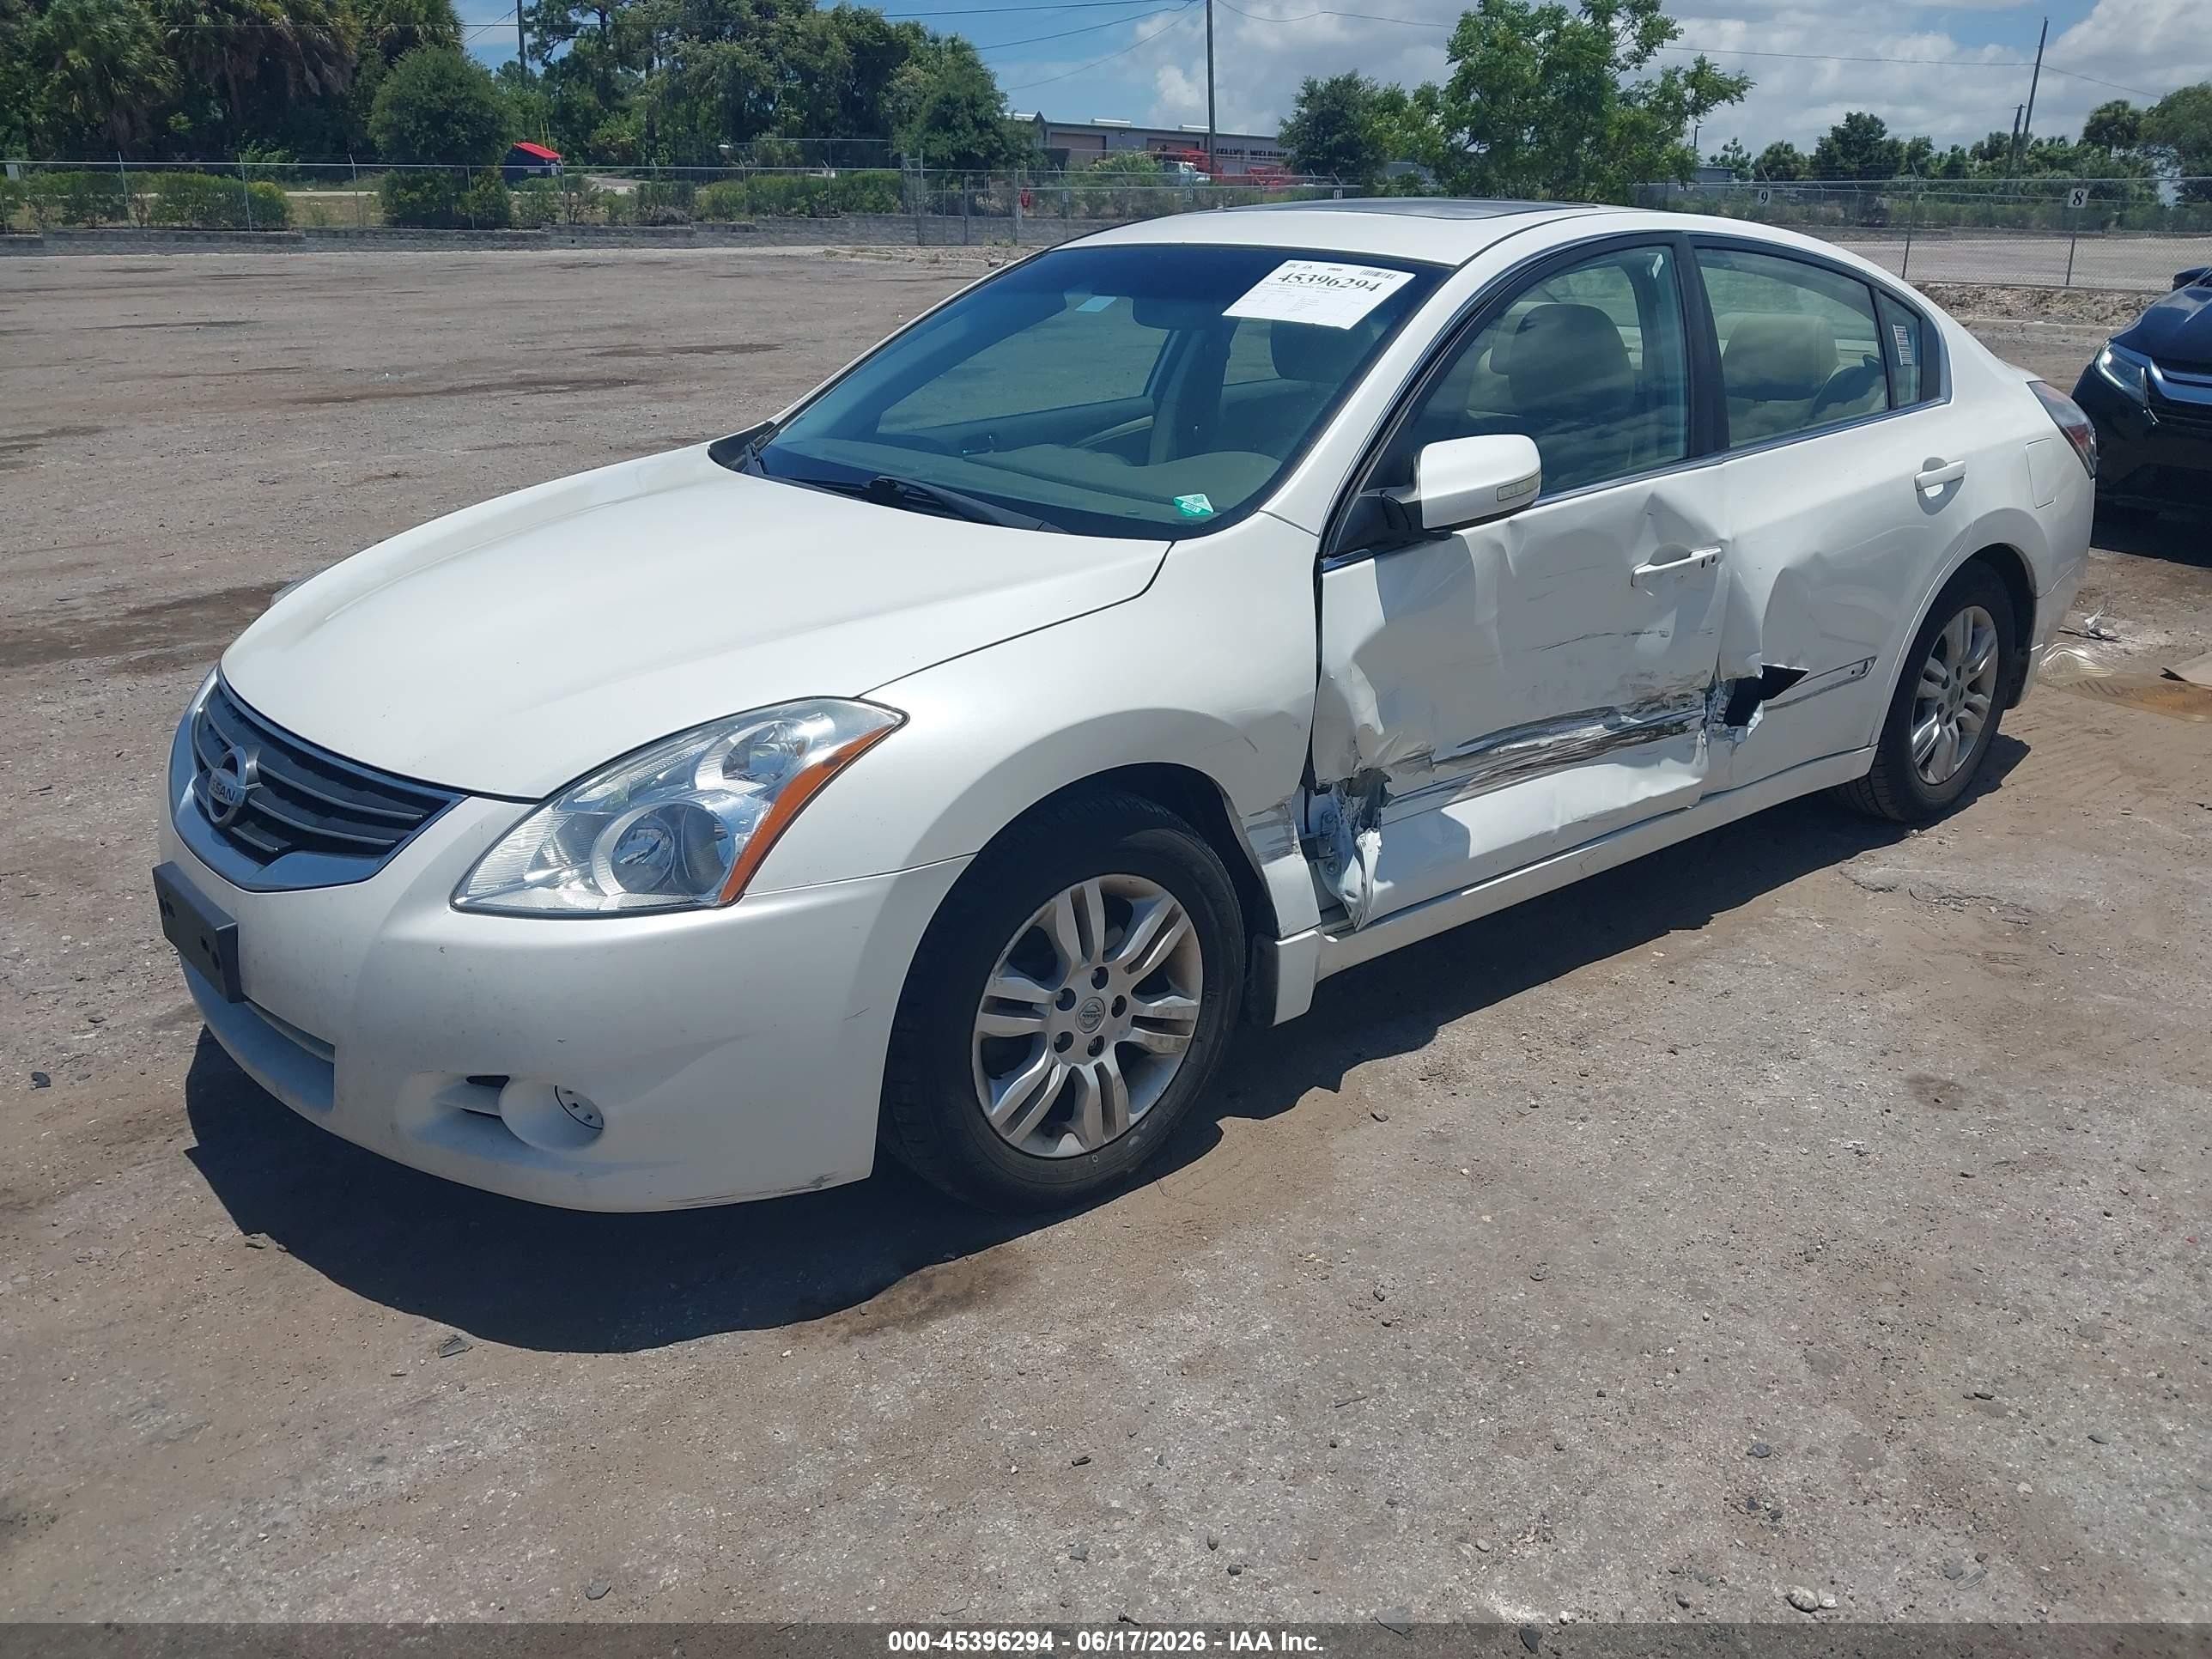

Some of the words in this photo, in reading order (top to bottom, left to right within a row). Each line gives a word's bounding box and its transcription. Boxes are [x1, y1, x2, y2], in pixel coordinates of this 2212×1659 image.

[1759, 191, 1769, 205] 9
[2072, 190, 2084, 206] 8
[1278, 273, 1383, 292] 45396294
